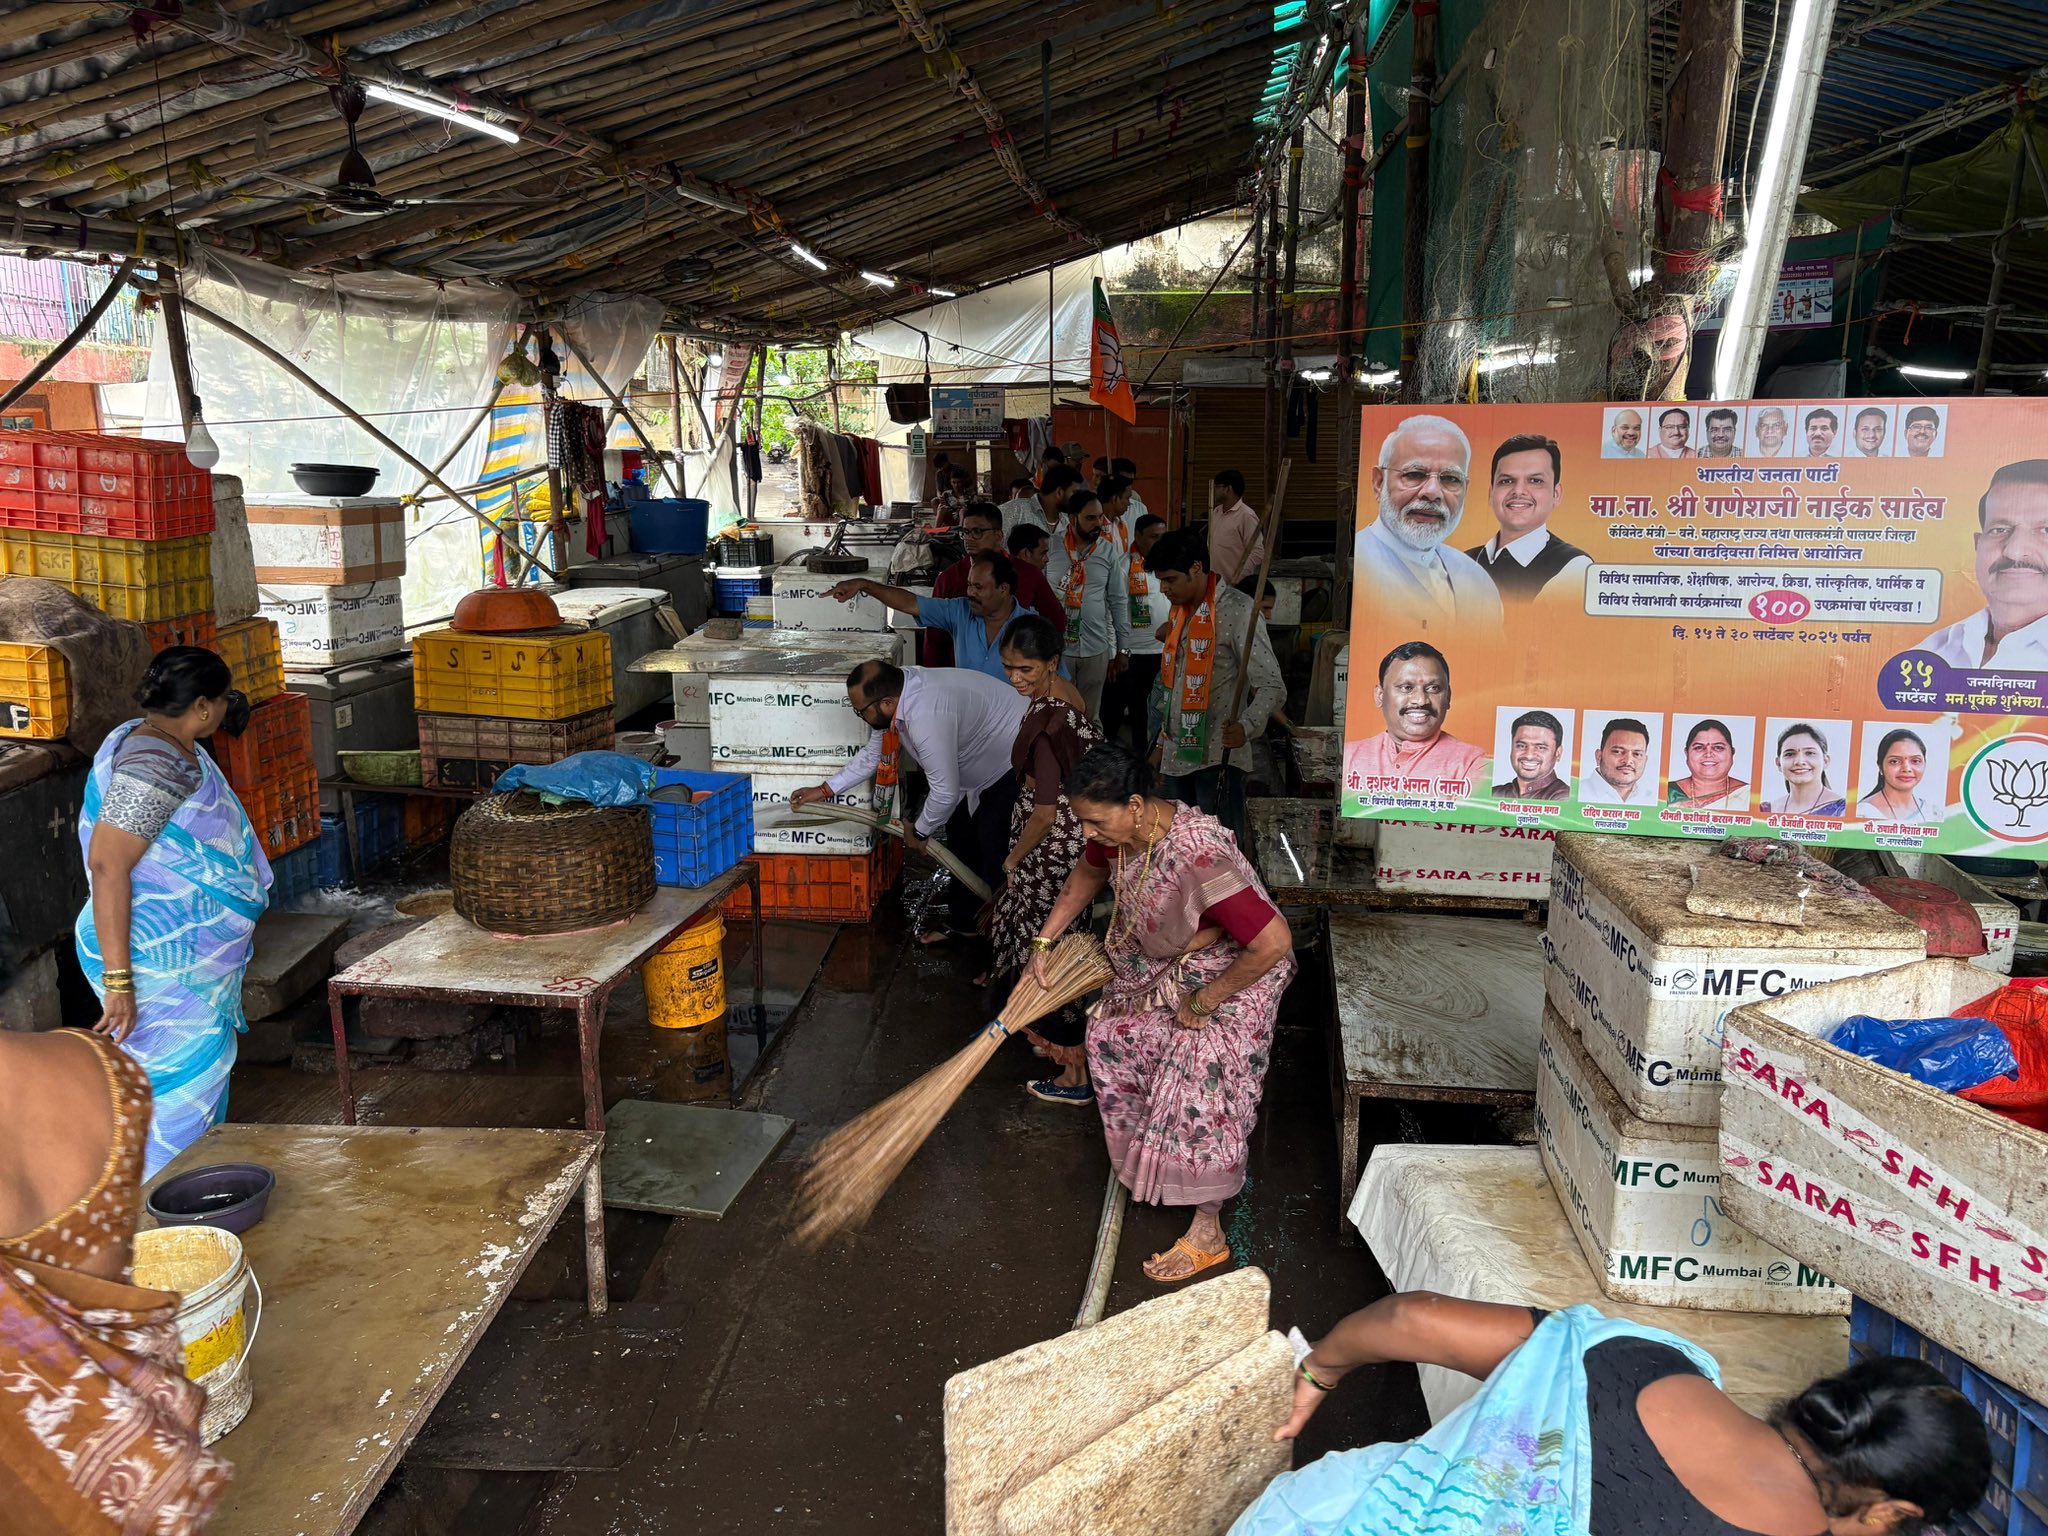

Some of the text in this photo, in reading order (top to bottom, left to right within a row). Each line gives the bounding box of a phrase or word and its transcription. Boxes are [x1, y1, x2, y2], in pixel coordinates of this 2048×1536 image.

[1698, 463, 1839, 482] भारतीय जनता पार्टी
[1590, 486, 1946, 523] मा.ना. श्री गणेशजी नाईक साहेब
[1645, 524, 1665, 538] मंत्री
[1701, 527, 1741, 542] महाराष्ट्र
[1743, 529, 1766, 539] राज्य
[1770, 530, 1790, 539] तथा
[1794, 527, 1843, 540] पालकमंत्री
[1847, 530, 1882, 541] पालघर
[1885, 527, 1916, 542] जिल्हा
[1655, 543, 1863, 560] यांच्या वाढदिवसा निमित्त आयोजित
[1599, 570, 1630, 585] विविध
[1876, 574, 1912, 589] धार्मिक
[1916, 579, 1925, 590] व
[790, 588, 814, 599] MFC
[287, 603, 316, 615] MFC
[1598, 592, 1629, 606] विविध
[1632, 592, 1676, 607] सेवाभावी
[1680, 594, 1742, 609] कार्यक्रमांच्या
[1756, 594, 1805, 618] १००
[1814, 596, 1865, 612] उपक्रमांचा
[1870, 597, 1913, 613] पंधरवडा
[1672, 625, 1688, 640] दि.
[1694, 627, 1712, 640] १५
[1716, 626, 1726, 640] ते
[1731, 629, 1749, 641] ३०
[1799, 630, 1838, 643] २०२५
[311, 638, 341, 651] MFC
[1900, 659, 1934, 688] १५
[1966, 675, 2037, 690] जन्मदिनाच्या
[777, 694, 812, 707] MFC
[1895, 688, 1938, 704] सप्टेंबर
[772, 746, 807, 758] MFC
[1347, 771, 1472, 799] श्री. दशरथ भगत (नाना)
[791, 830, 826, 845] MFC
[827, 836, 853, 844] Mumbai
[1499, 826, 1556, 842] SARA
[1416, 869, 1541, 883] SARA SFH
[1610, 926, 1637, 973] MFC
[1702, 968, 1787, 997] MFC
[1575, 975, 1599, 1021] MFC
[1625, 1038, 1673, 1087] MFC
[1676, 1068, 1722, 1082] Mumb
[1569, 1083, 1589, 1130] MFC
[1736, 1047, 1970, 1222] SARA SFH
[1569, 1175, 1589, 1231] MFC
[1619, 1255, 1699, 1283] MFC
[1703, 1265, 1763, 1279] Mumbai
[1758, 1160, 1857, 1228] SARA
[1911, 1231, 2000, 1292] SFH
